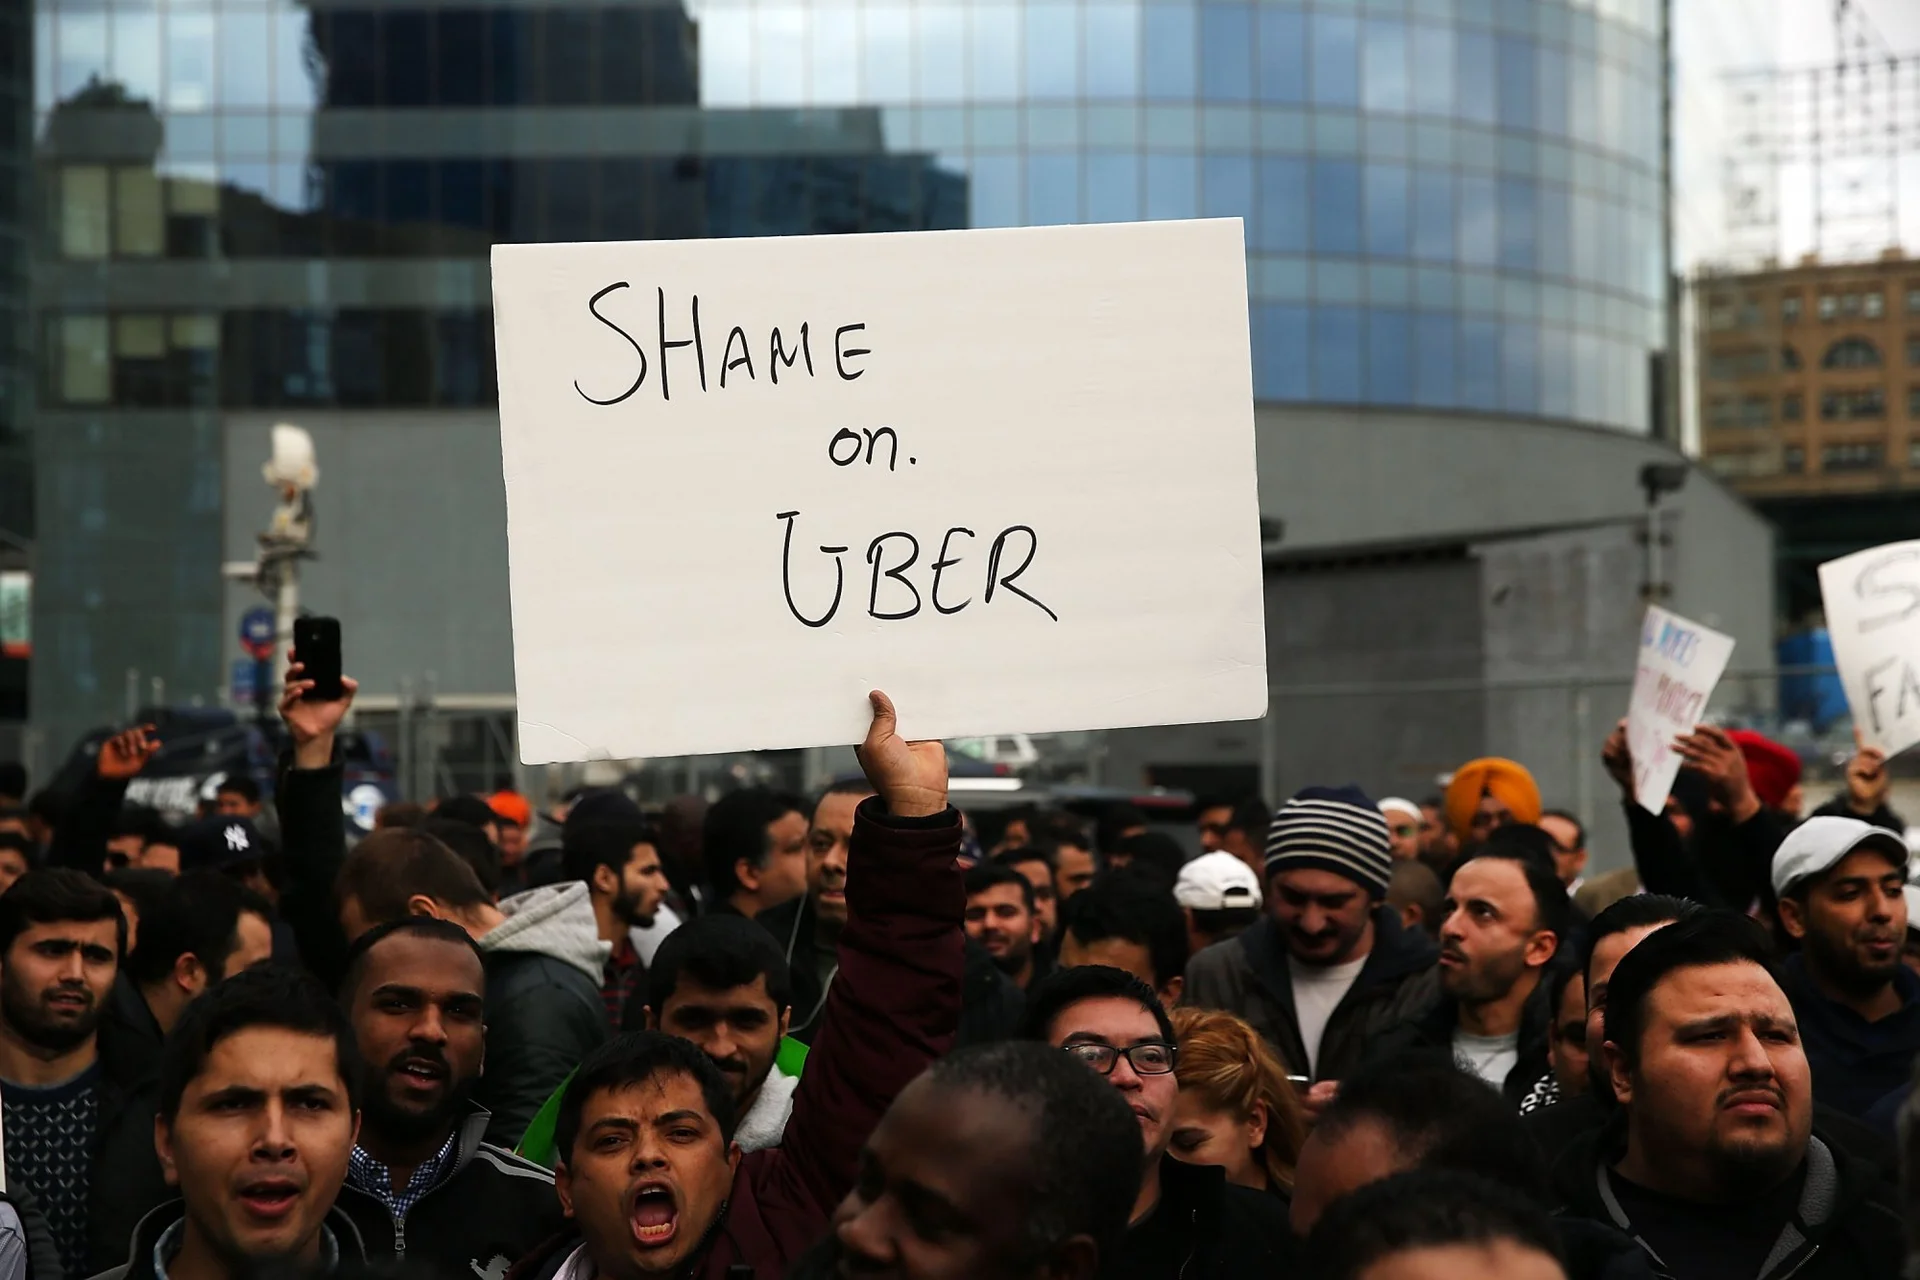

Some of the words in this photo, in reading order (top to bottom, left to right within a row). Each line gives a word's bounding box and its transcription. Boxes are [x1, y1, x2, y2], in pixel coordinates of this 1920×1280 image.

[574, 281, 872, 406] SHAME
[828, 426, 917, 472] on.
[776, 510, 1058, 628] UBER
[223, 822, 250, 852] NY
